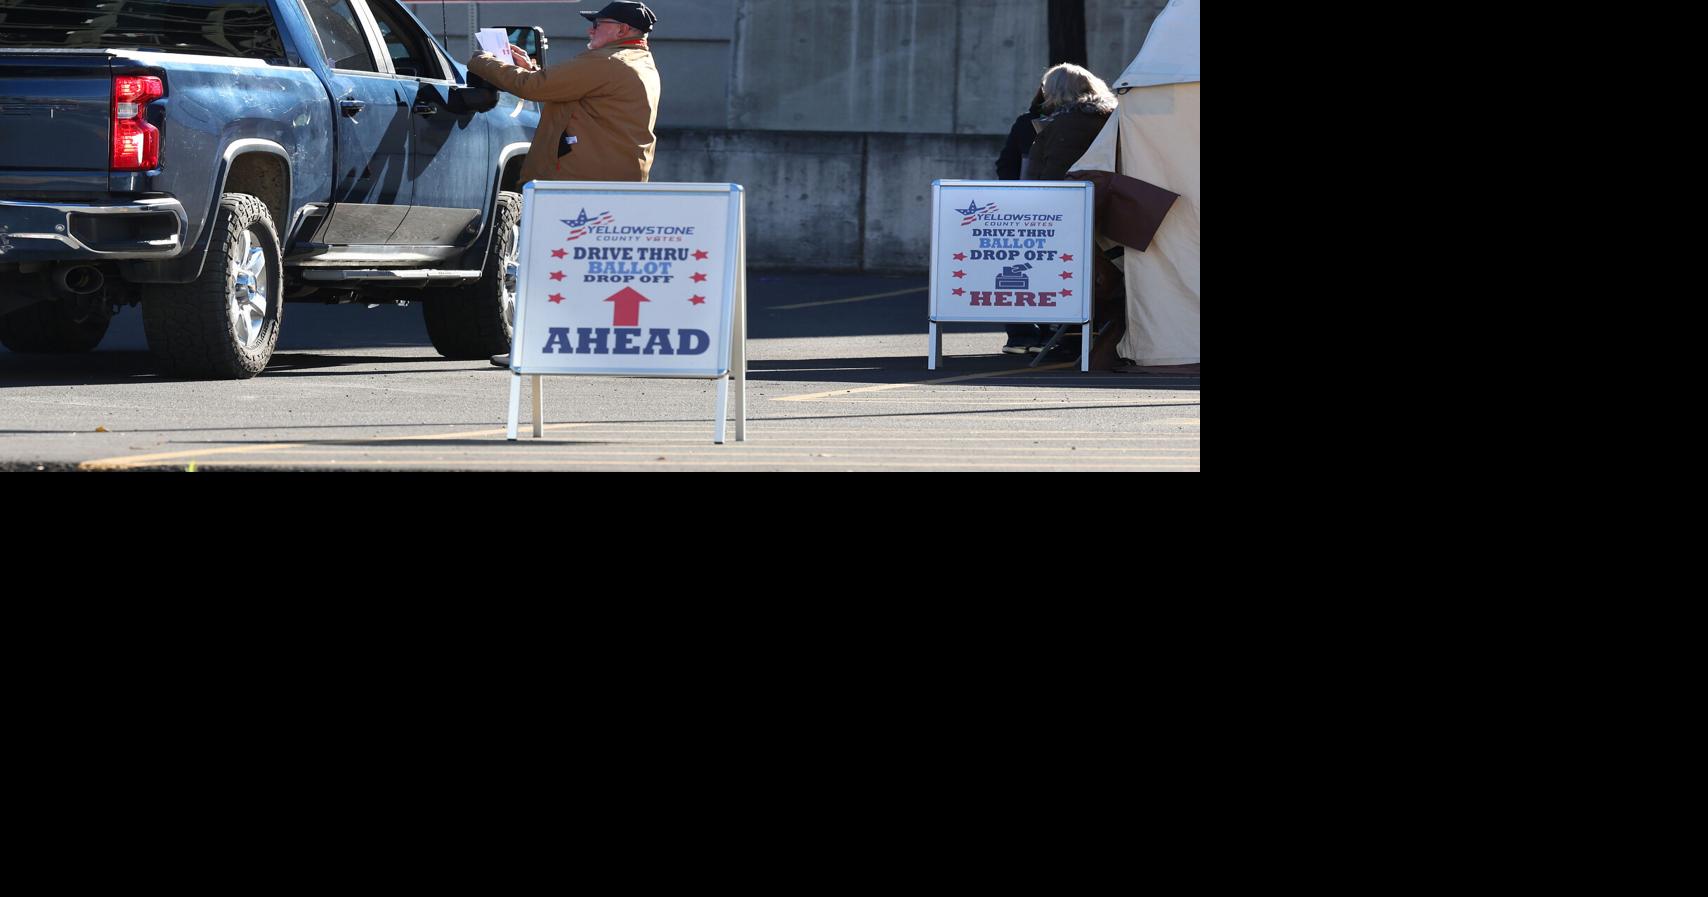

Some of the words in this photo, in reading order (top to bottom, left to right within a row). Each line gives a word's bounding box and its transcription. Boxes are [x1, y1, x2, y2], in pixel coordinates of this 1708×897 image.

[977, 213, 1063, 222] YELLOWSTONE
[587, 226, 695, 235] YELLOWSTONE
[972, 229, 1015, 237] DRIVE
[1017, 229, 1055, 238] THRU
[979, 238, 1046, 249] BALLOT
[573, 247, 633, 260] DRIVE
[637, 248, 689, 261] THRU
[970, 250, 1020, 261] DROP
[1024, 251, 1057, 261] OFF
[588, 261, 672, 275] BALLOT
[583, 274, 635, 283] DROP
[639, 275, 674, 284] OFF
[970, 291, 1057, 307] HERE
[542, 327, 710, 356] AHEAD
